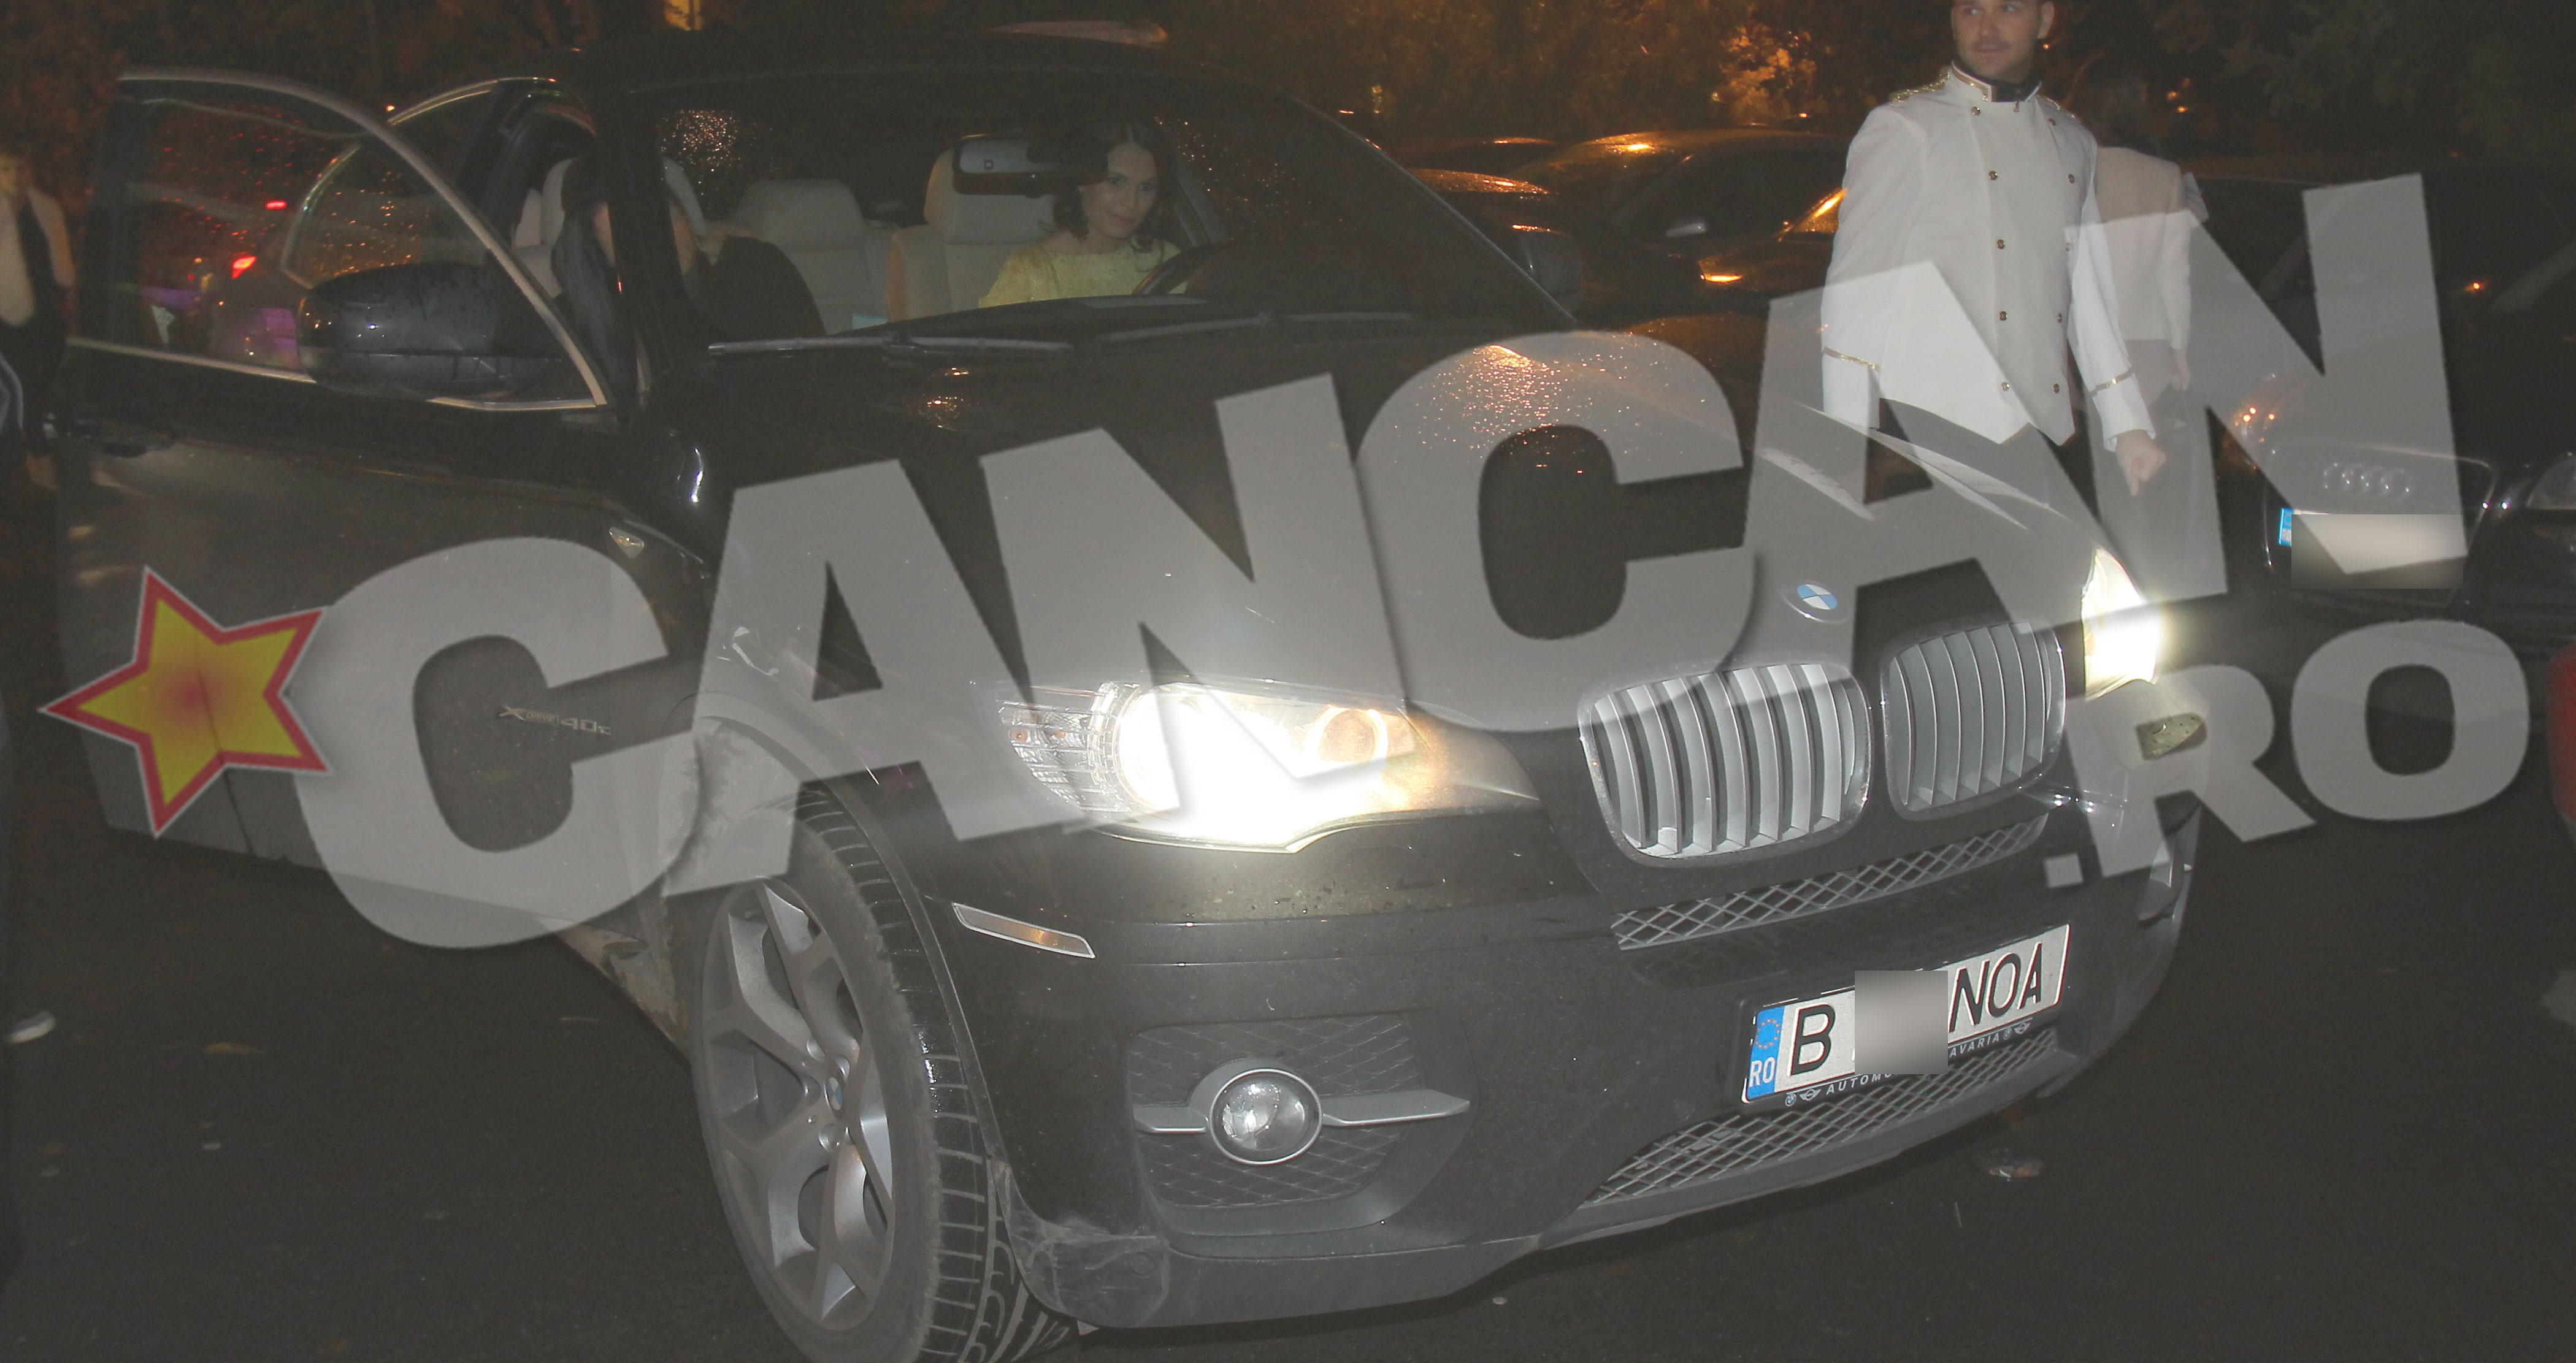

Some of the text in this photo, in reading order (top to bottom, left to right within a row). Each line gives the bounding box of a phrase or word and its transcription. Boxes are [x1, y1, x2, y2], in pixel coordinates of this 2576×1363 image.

[1789, 1004, 1836, 1077] B
[1947, 942, 2042, 1034] NOA
[1948, 1032, 2000, 1058] AVARIA
[1749, 1059, 1776, 1088] RO
